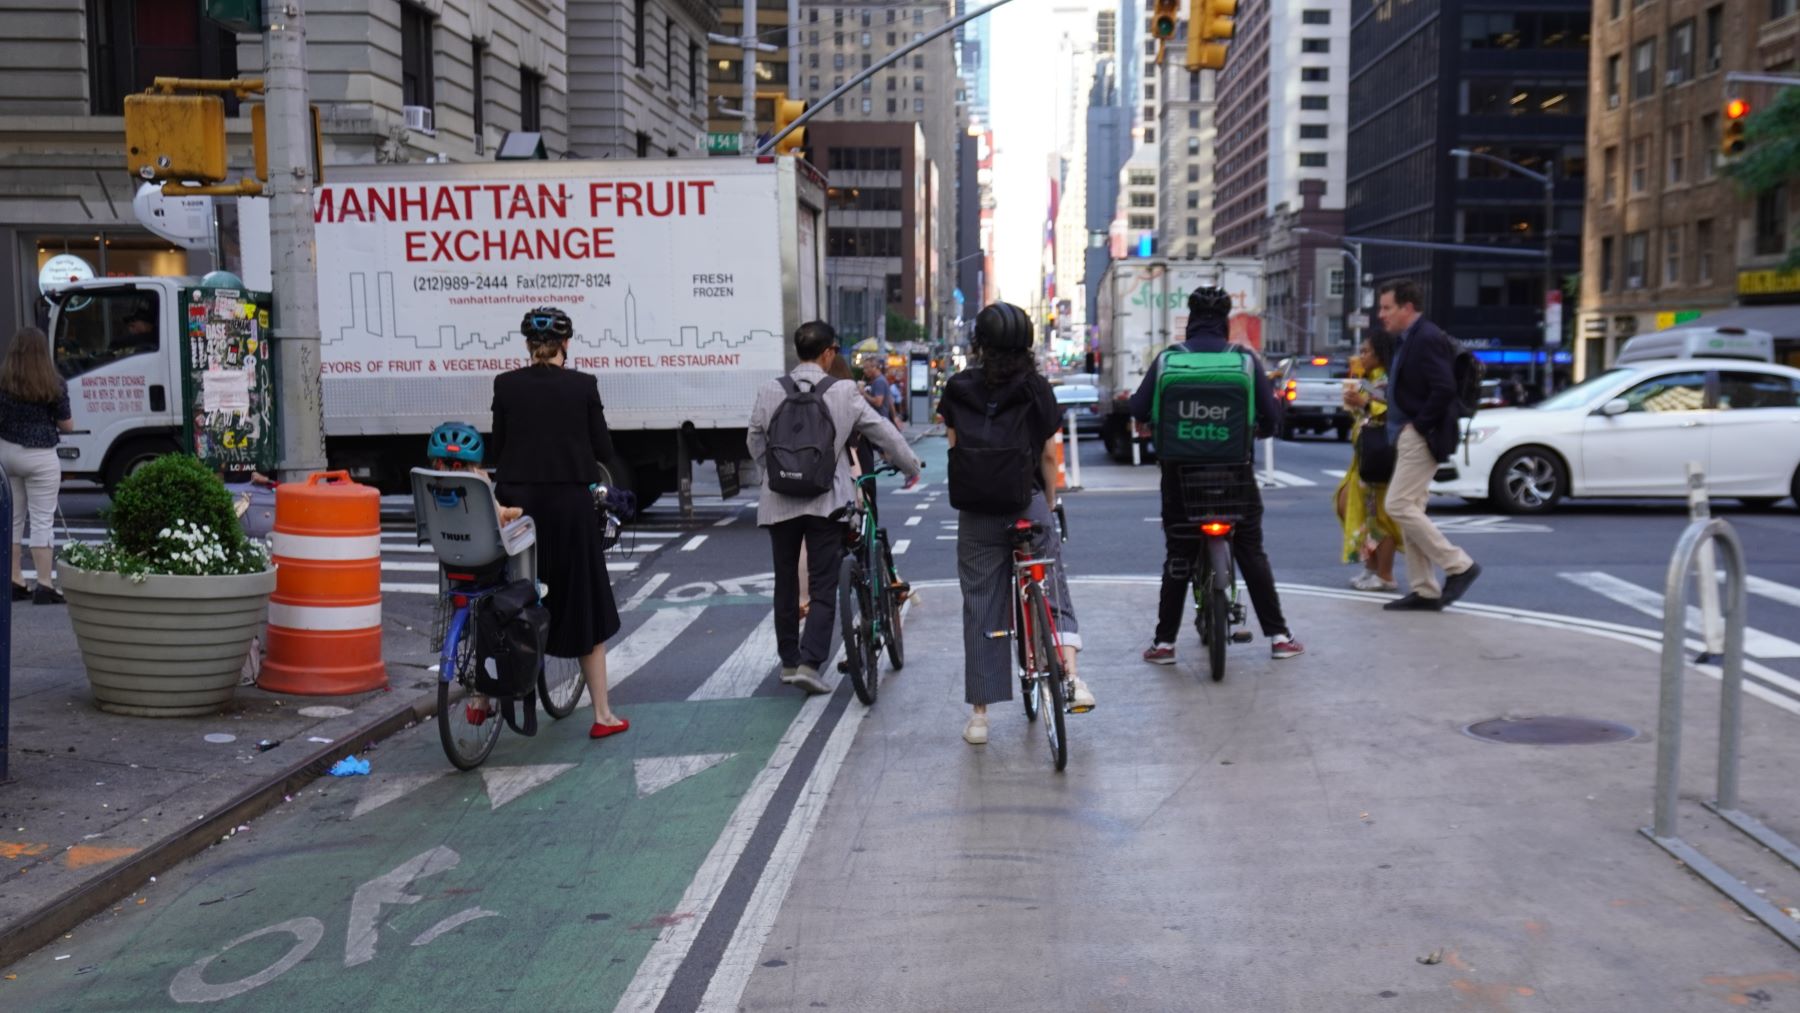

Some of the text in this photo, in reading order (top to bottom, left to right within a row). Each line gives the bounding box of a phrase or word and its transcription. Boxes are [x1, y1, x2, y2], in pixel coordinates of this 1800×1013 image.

[707, 133, 716, 148] W
[717, 134, 731, 149] 54
[314, 180, 715, 223] MANHATTAN FRUIT
[405, 227, 615, 263] EXCHANGE
[413, 275, 508, 292] (212)989-2444
[692, 273, 734, 285] FRESH
[693, 287, 734, 298] FROZEN
[320, 360, 362, 374] EYORS
[367, 360, 384, 373] OF
[388, 360, 423, 373] FRUIT
[428, 360, 438, 372] &
[442, 358, 521, 372] VEGETABLES
[574, 356, 610, 370] FINER
[1178, 399, 1231, 420] Uber
[1177, 420, 1230, 441] Eats
[440, 531, 471, 542] THULE
